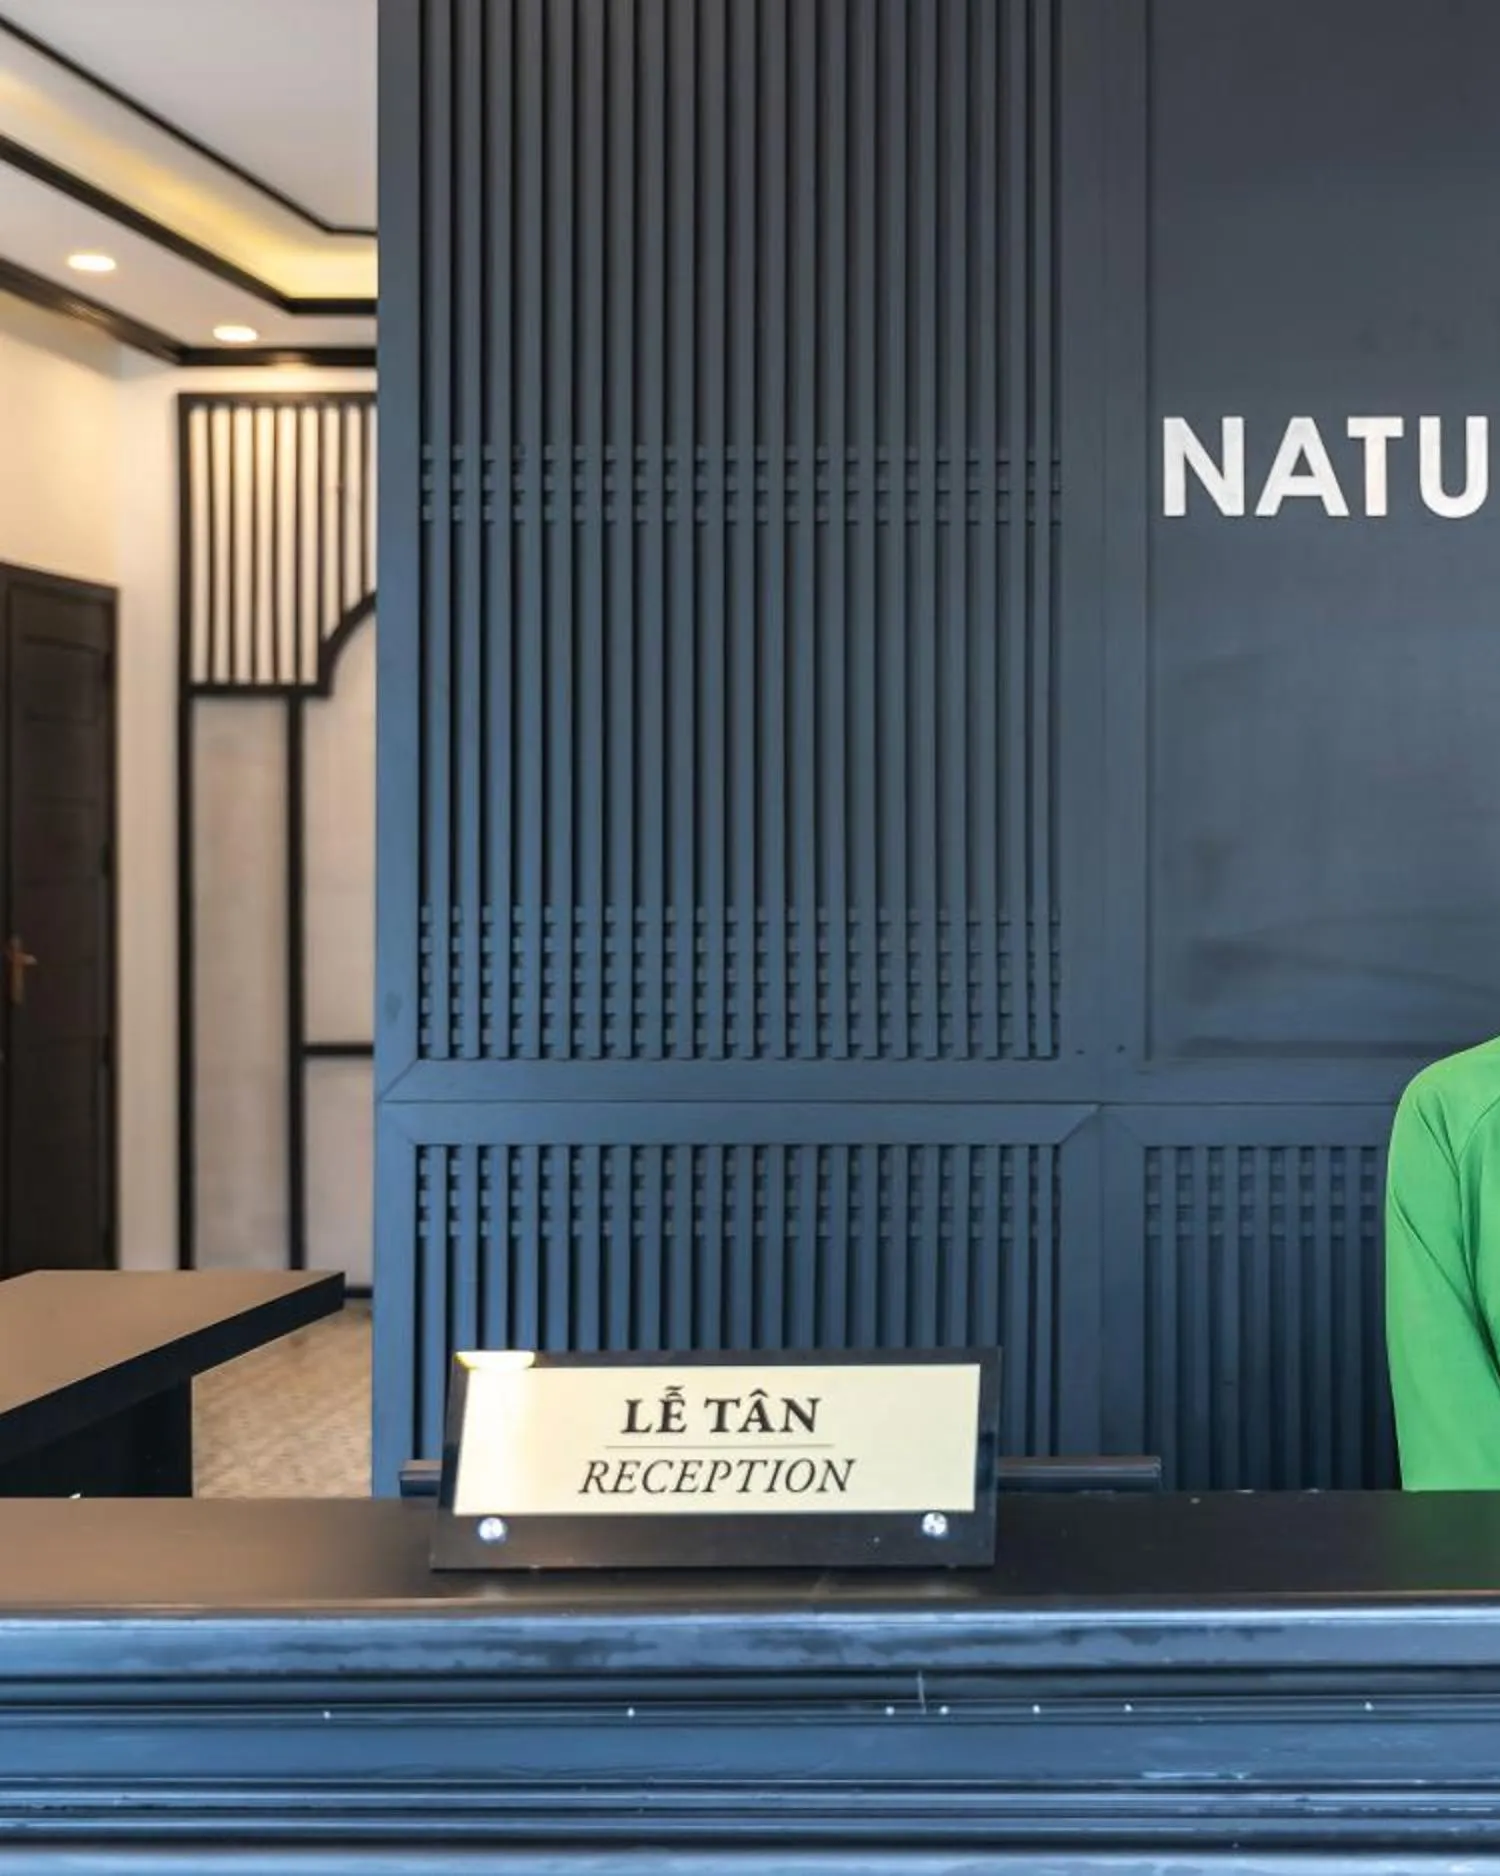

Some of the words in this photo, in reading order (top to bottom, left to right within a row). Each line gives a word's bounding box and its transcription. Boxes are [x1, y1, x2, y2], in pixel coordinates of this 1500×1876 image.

[620, 1385, 688, 1434] LỄ
[704, 1388, 821, 1433] TÂN
[578, 1458, 856, 1495] RECEPTION
